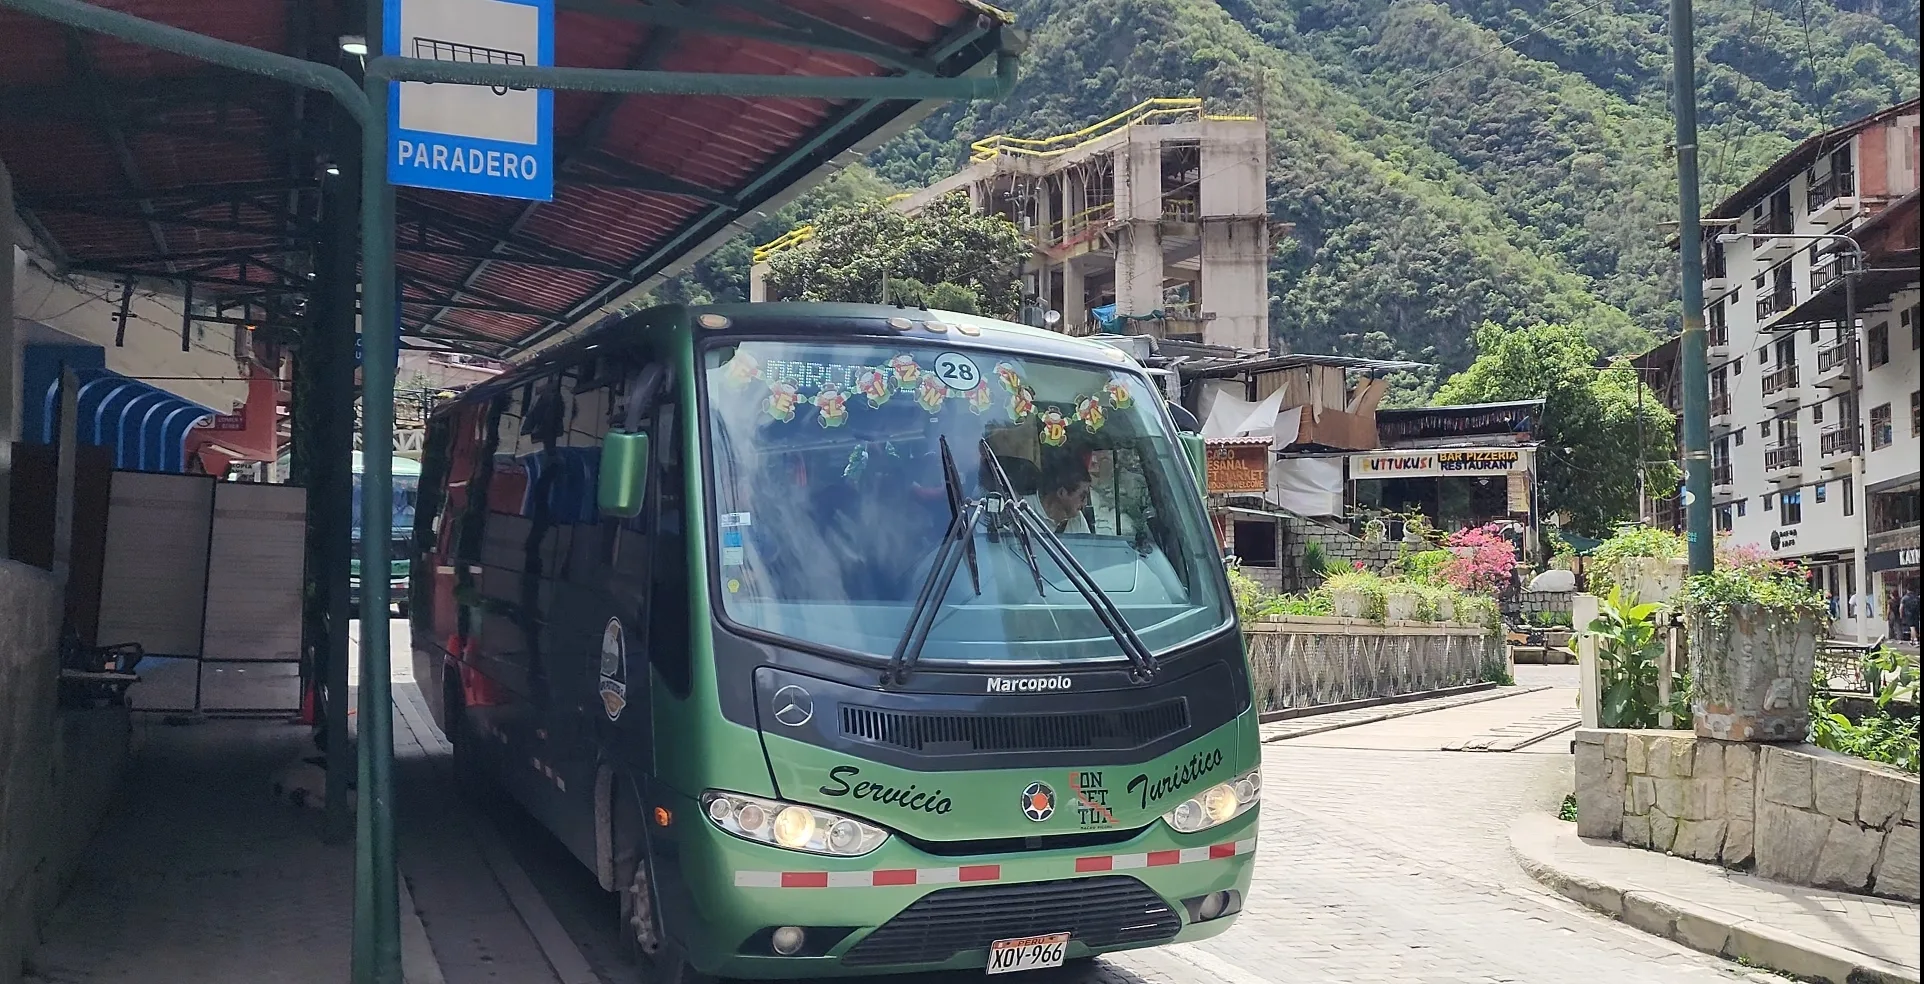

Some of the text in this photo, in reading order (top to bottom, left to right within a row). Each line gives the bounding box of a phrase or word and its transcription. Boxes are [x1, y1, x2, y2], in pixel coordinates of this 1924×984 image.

[398, 140, 537, 180] PARADERO
[941, 361, 974, 381] 28
[1361, 455, 1433, 472] PUTTUKUSI
[1440, 451, 1518, 461] BAR PIZZERIA
[1441, 460, 1514, 470] RESTAURANT
[1220, 470, 1264, 480] MARKET
[987, 676, 1071, 692] Marcopolo
[1127, 748, 1223, 809] Turistico
[819, 765, 952, 814] Servicio
[992, 943, 1062, 969] XOY-966
